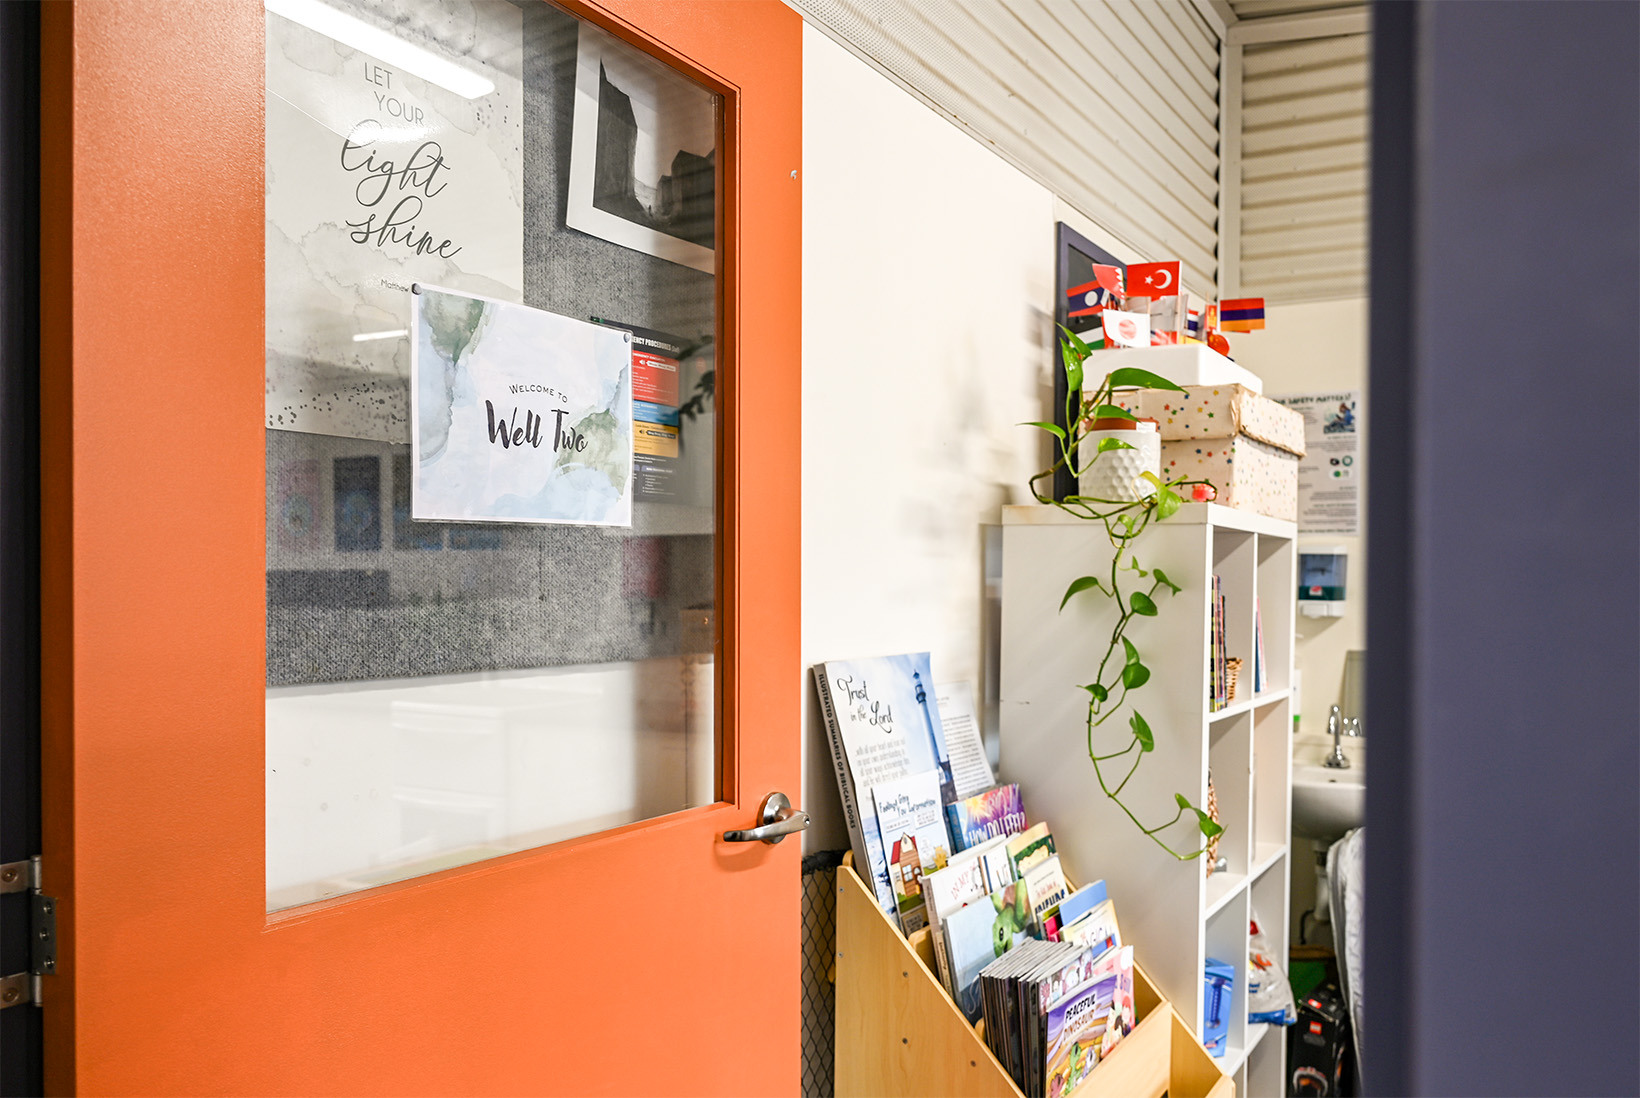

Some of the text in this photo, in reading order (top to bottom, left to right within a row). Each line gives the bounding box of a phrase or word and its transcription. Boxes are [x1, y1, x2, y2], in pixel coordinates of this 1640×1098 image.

[364, 62, 393, 90] LET
[373, 91, 425, 126] YOUR
[345, 195, 463, 259] shine
[508, 383, 555, 397] WELCOME
[485, 399, 543, 449] Well
[550, 408, 589, 453] Two
[837, 675, 870, 706] Trust
[869, 700, 894, 734] Lord
[818, 673, 857, 829] ILLUSTRATED SUMMARIES OF BIBLICAL BOOKS
[1065, 993, 1096, 1024] PEACEFUL
